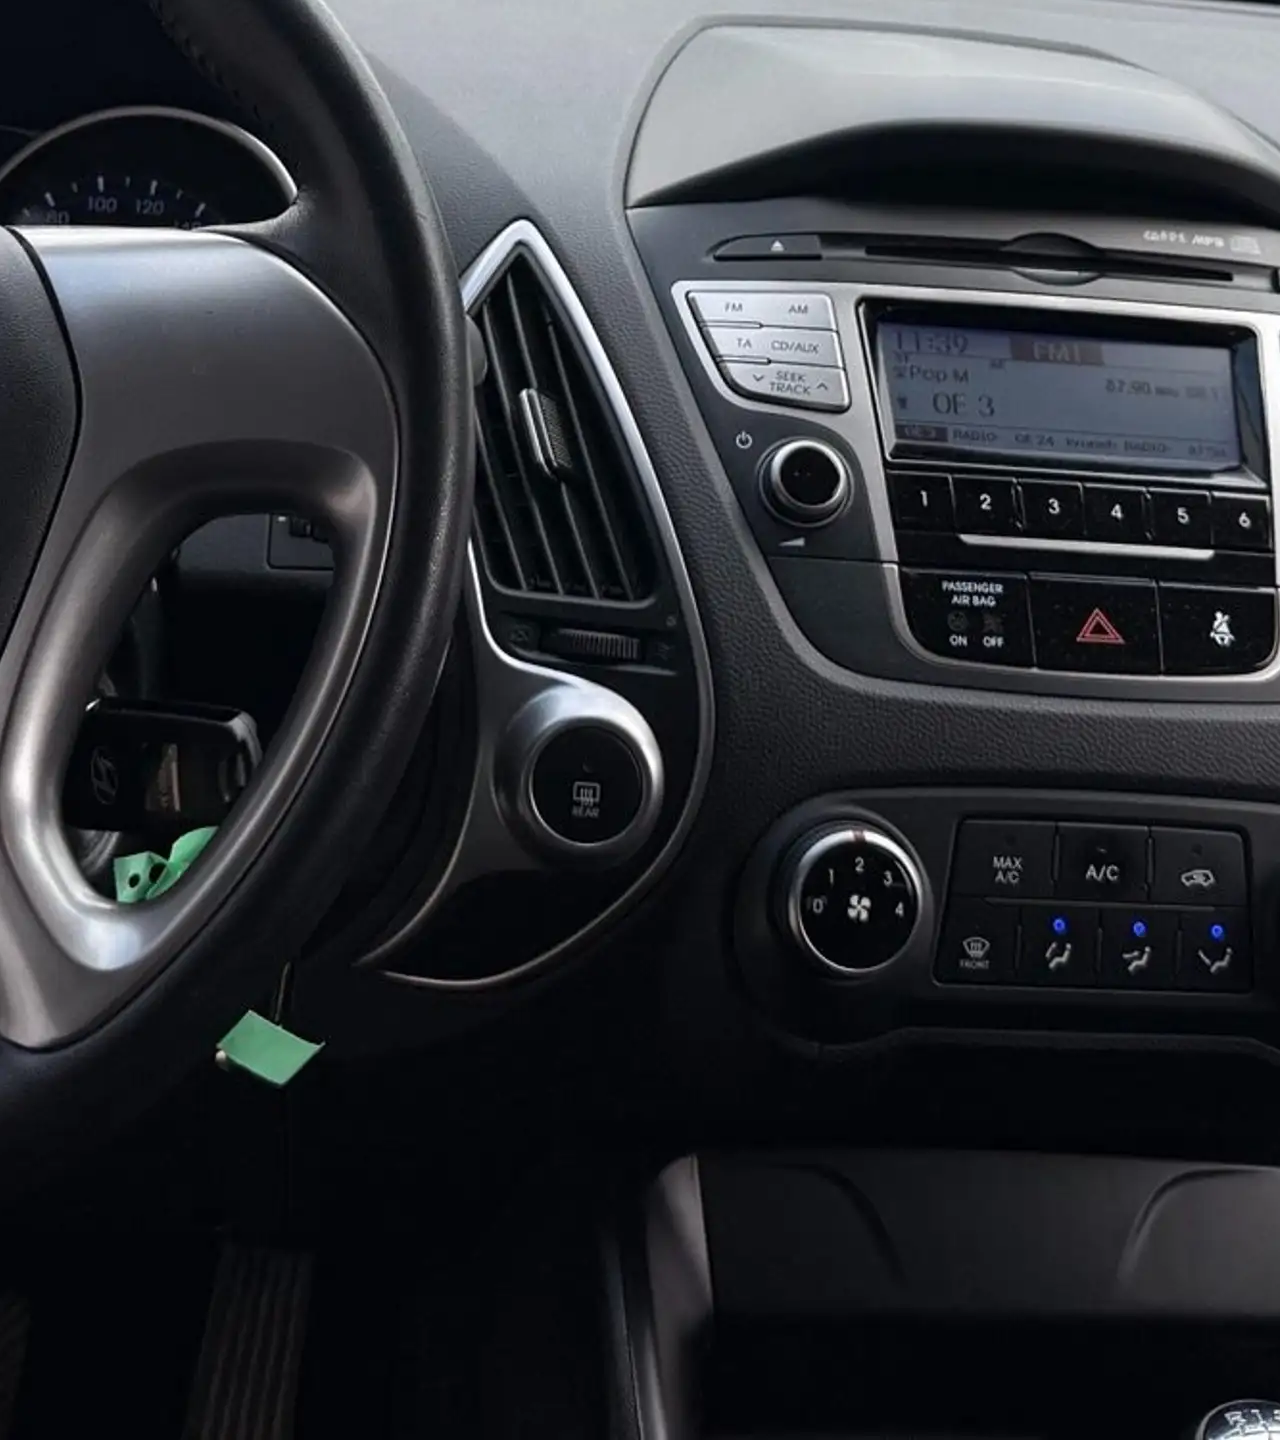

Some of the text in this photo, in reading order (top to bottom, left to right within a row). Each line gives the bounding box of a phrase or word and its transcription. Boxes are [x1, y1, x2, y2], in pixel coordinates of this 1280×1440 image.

[87, 195, 118, 212] 100
[135, 198, 165, 216] 120
[724, 302, 743, 312] FM
[788, 304, 809, 315] AM
[737, 337, 753, 349] TA
[771, 339, 820, 355] CD/AUX
[776, 370, 806, 383] SEEK
[770, 382, 812, 395] TRACK
[977, 393, 996, 418] 3
[921, 489, 928, 507] 1
[979, 493, 992, 510] 2
[1048, 497, 1060, 514] 3
[1110, 503, 1124, 520] 4
[1177, 506, 1190, 525] 5
[1238, 512, 1251, 529] 6
[941, 580, 1004, 594] PASSENGER
[951, 594, 996, 607] AIR BAG
[948, 634, 968, 647] ON
[982, 635, 1005, 648] OFF
[854, 855, 865, 873] 2
[992, 856, 1023, 870] MAX
[827, 867, 835, 886] 1
[882, 869, 894, 888] 3
[994, 870, 1021, 884] A/C
[1085, 863, 1120, 882] A/C
[894, 901, 905, 918] 4
